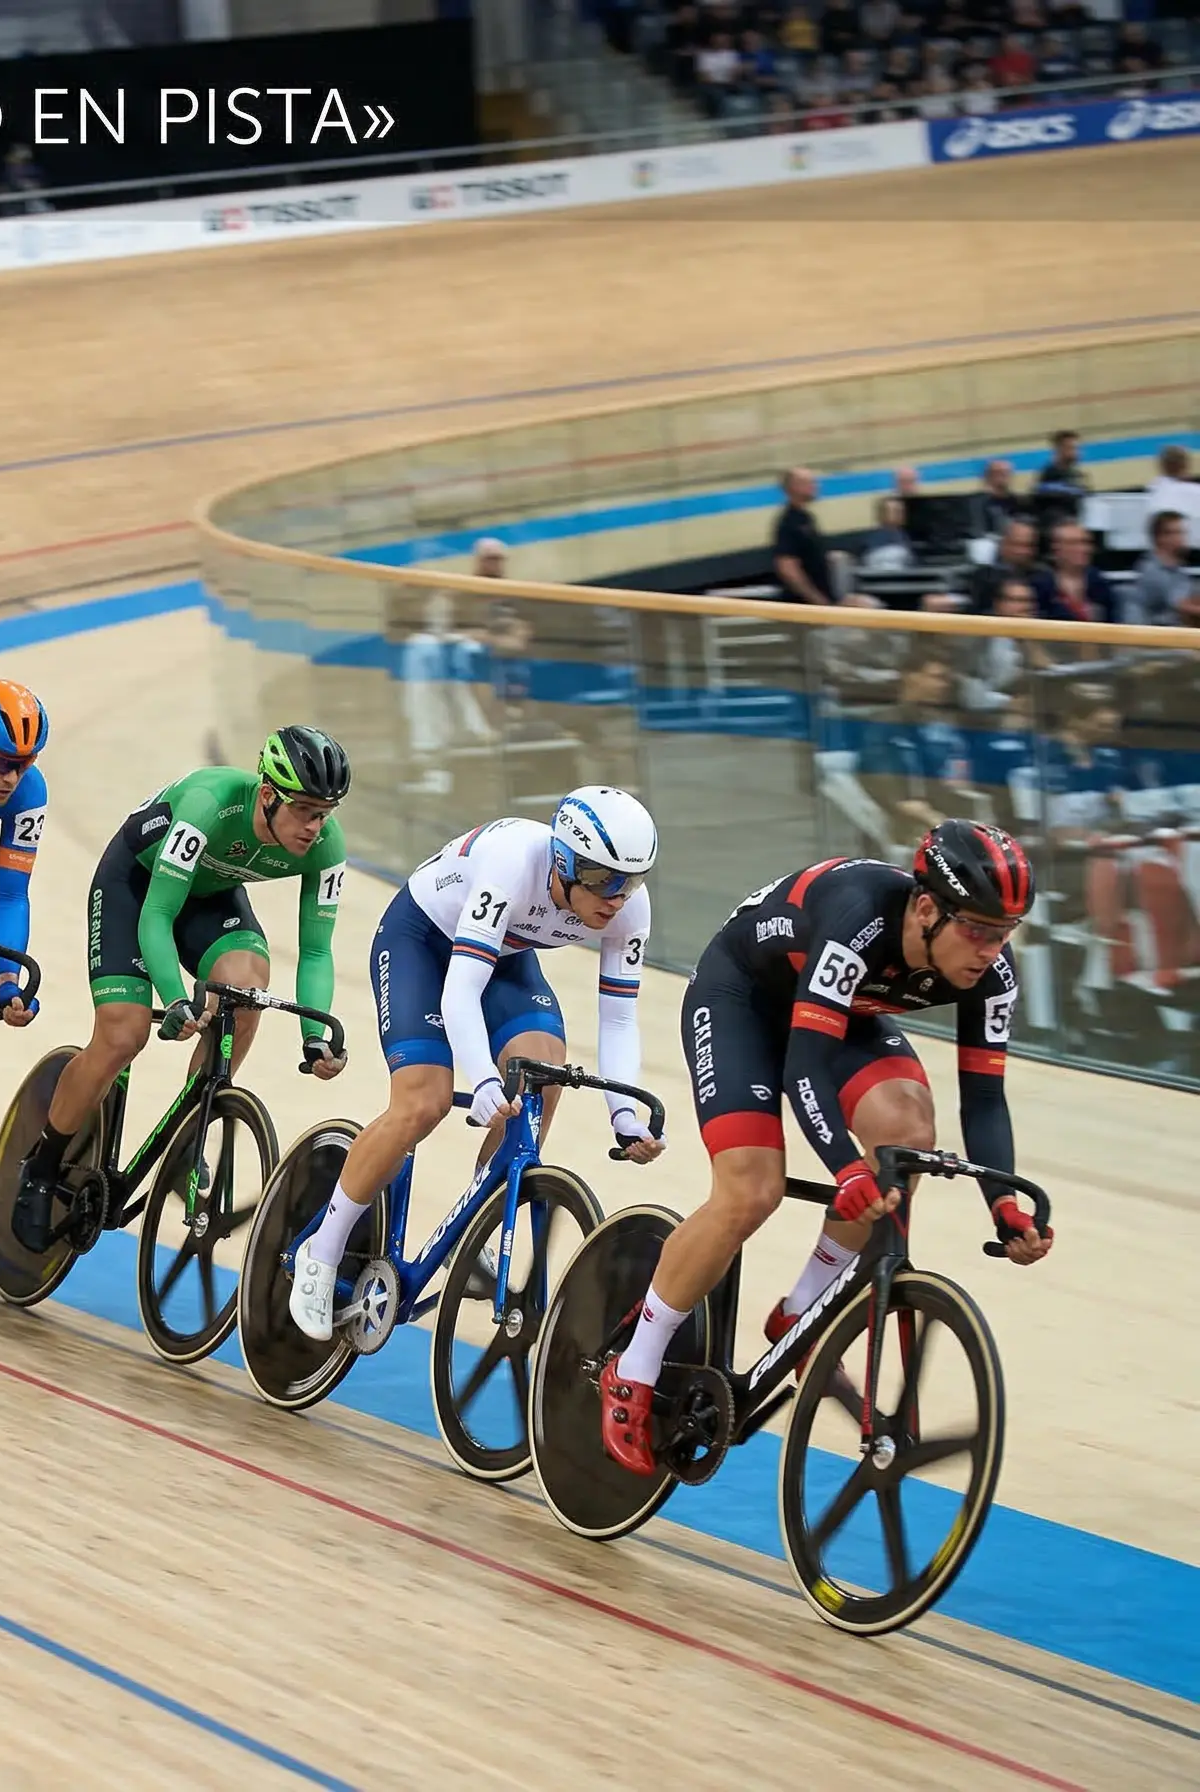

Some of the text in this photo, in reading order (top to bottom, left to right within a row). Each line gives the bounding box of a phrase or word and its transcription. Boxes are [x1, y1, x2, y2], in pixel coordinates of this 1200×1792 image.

[457, 173, 570, 204] TISSOT
[248, 194, 360, 225] TISSOT
[169, 828, 201, 862] 19
[471, 891, 508, 928] 31
[626, 937, 648, 966] 3
[818, 952, 859, 997] 58
[990, 1002, 1011, 1040] 5
